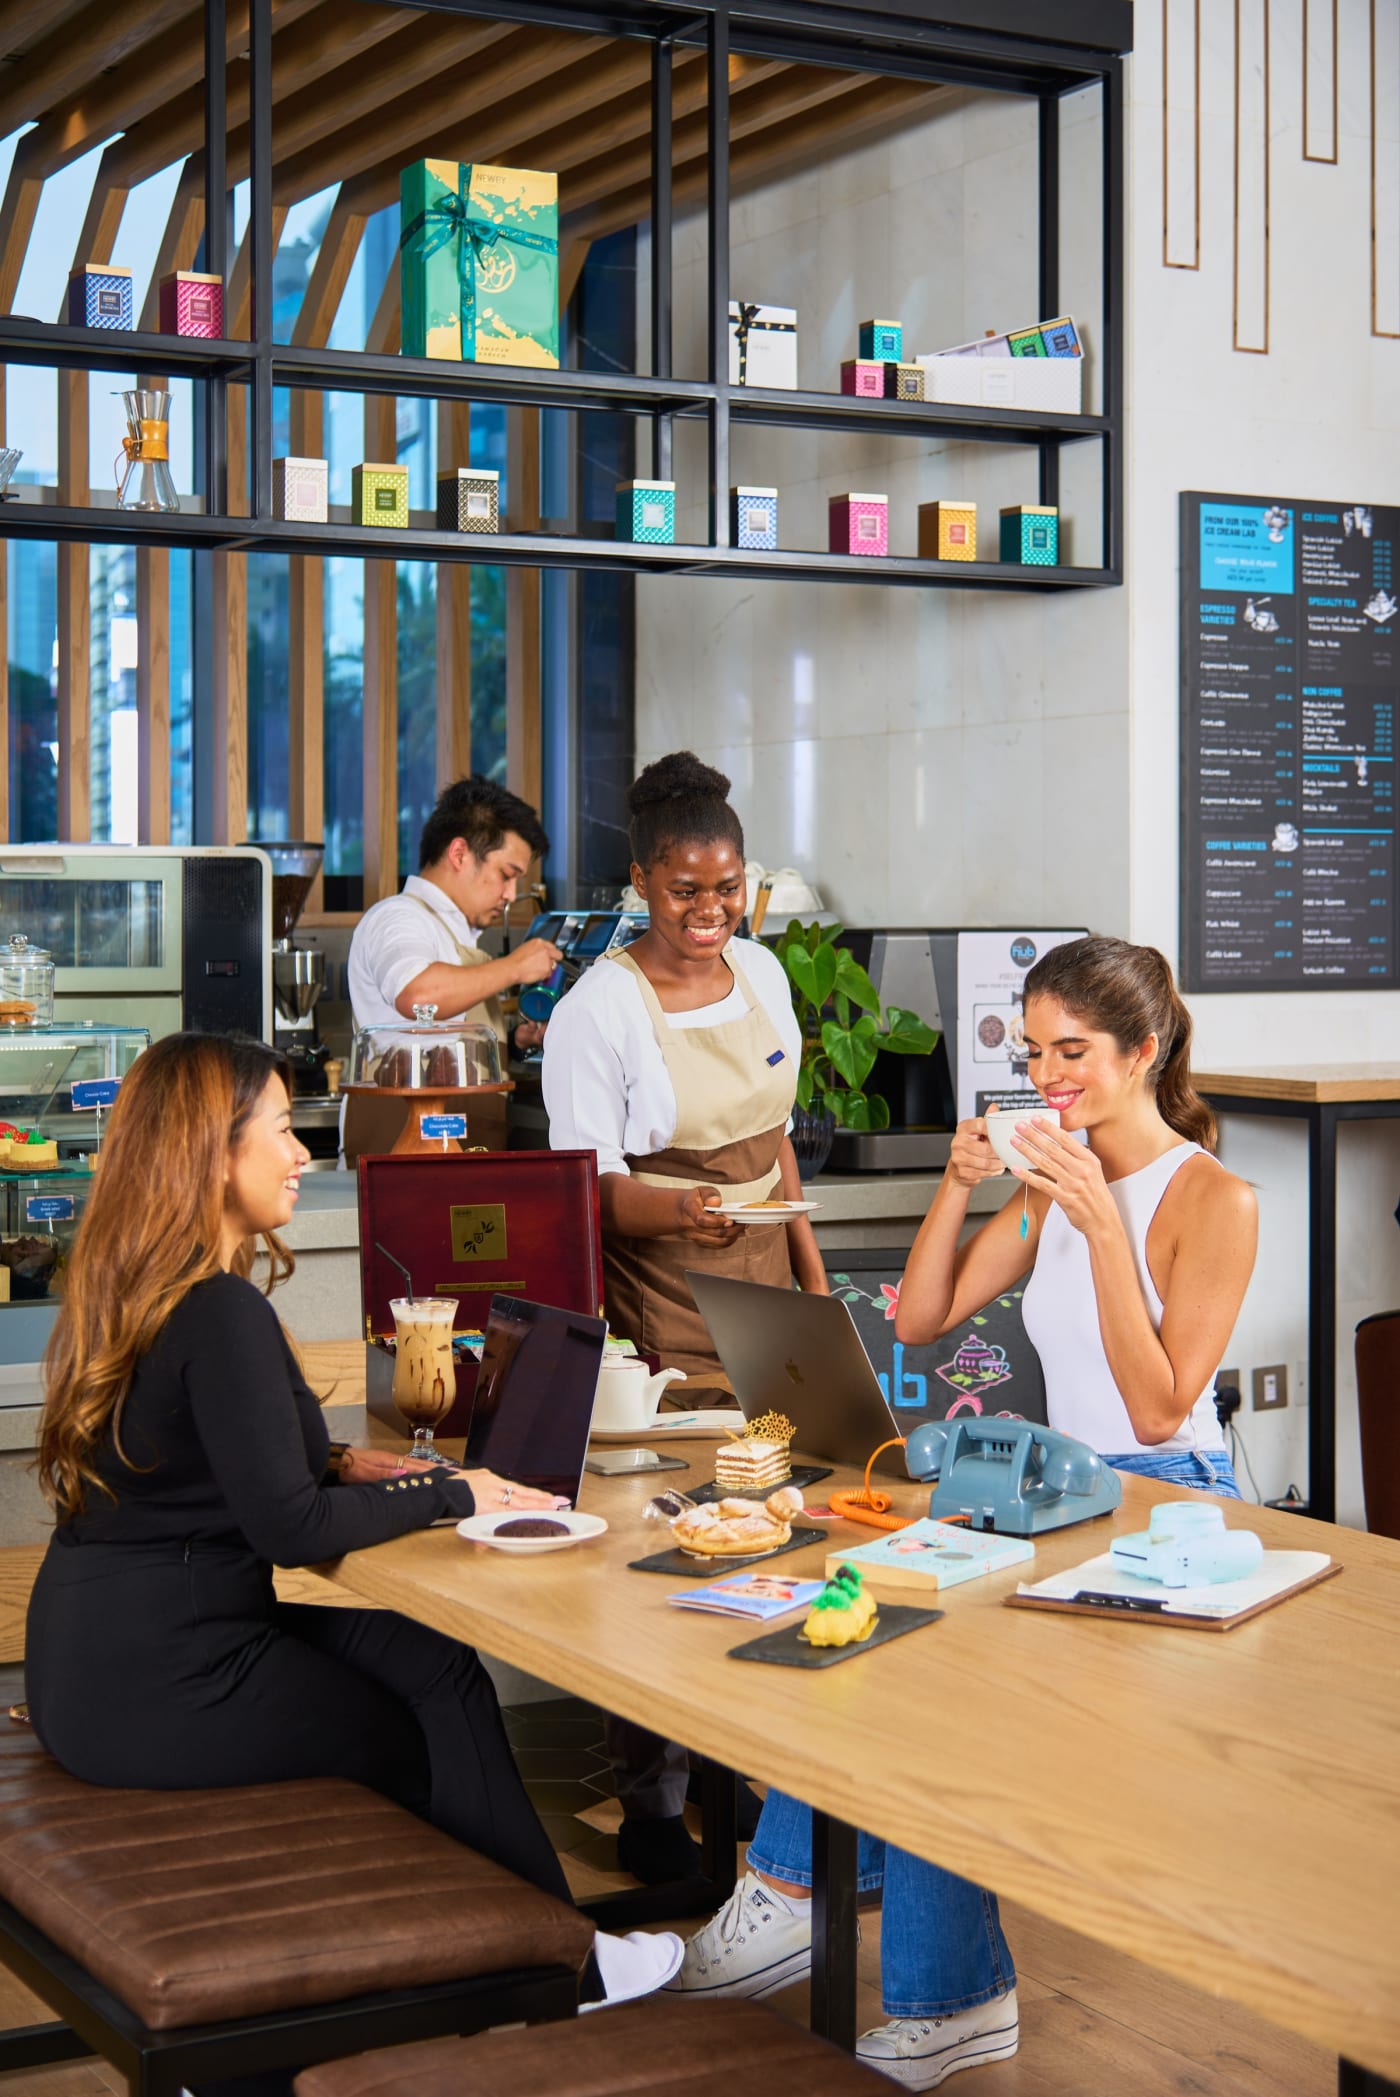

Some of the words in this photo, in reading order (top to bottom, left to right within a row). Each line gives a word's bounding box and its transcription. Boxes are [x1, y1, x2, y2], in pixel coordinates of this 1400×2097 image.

[1204, 515, 1224, 525] FROM
[1226, 517, 1239, 526] OUR
[1204, 527, 1215, 536] ICE
[1216, 528, 1240, 537] CREAM
[1242, 529, 1256, 538] LAB
[1308, 596, 1342, 607] SPECIALTY
[1344, 598, 1358, 608] TEA
[1200, 604, 1236, 614] ESPRESSO
[1200, 615, 1235, 625] VARIETIES
[1200, 632, 1228, 642] Espresso
[1200, 661, 1228, 670] Espresso
[1318, 687, 1343, 697] COFFEE
[1200, 748, 1228, 756] Espresso
[1200, 796, 1228, 805] Espresso
[1206, 841, 1231, 850] COFFEE
[1233, 841, 1267, 850] VARIETIES
[1012, 945, 1035, 958] hub
